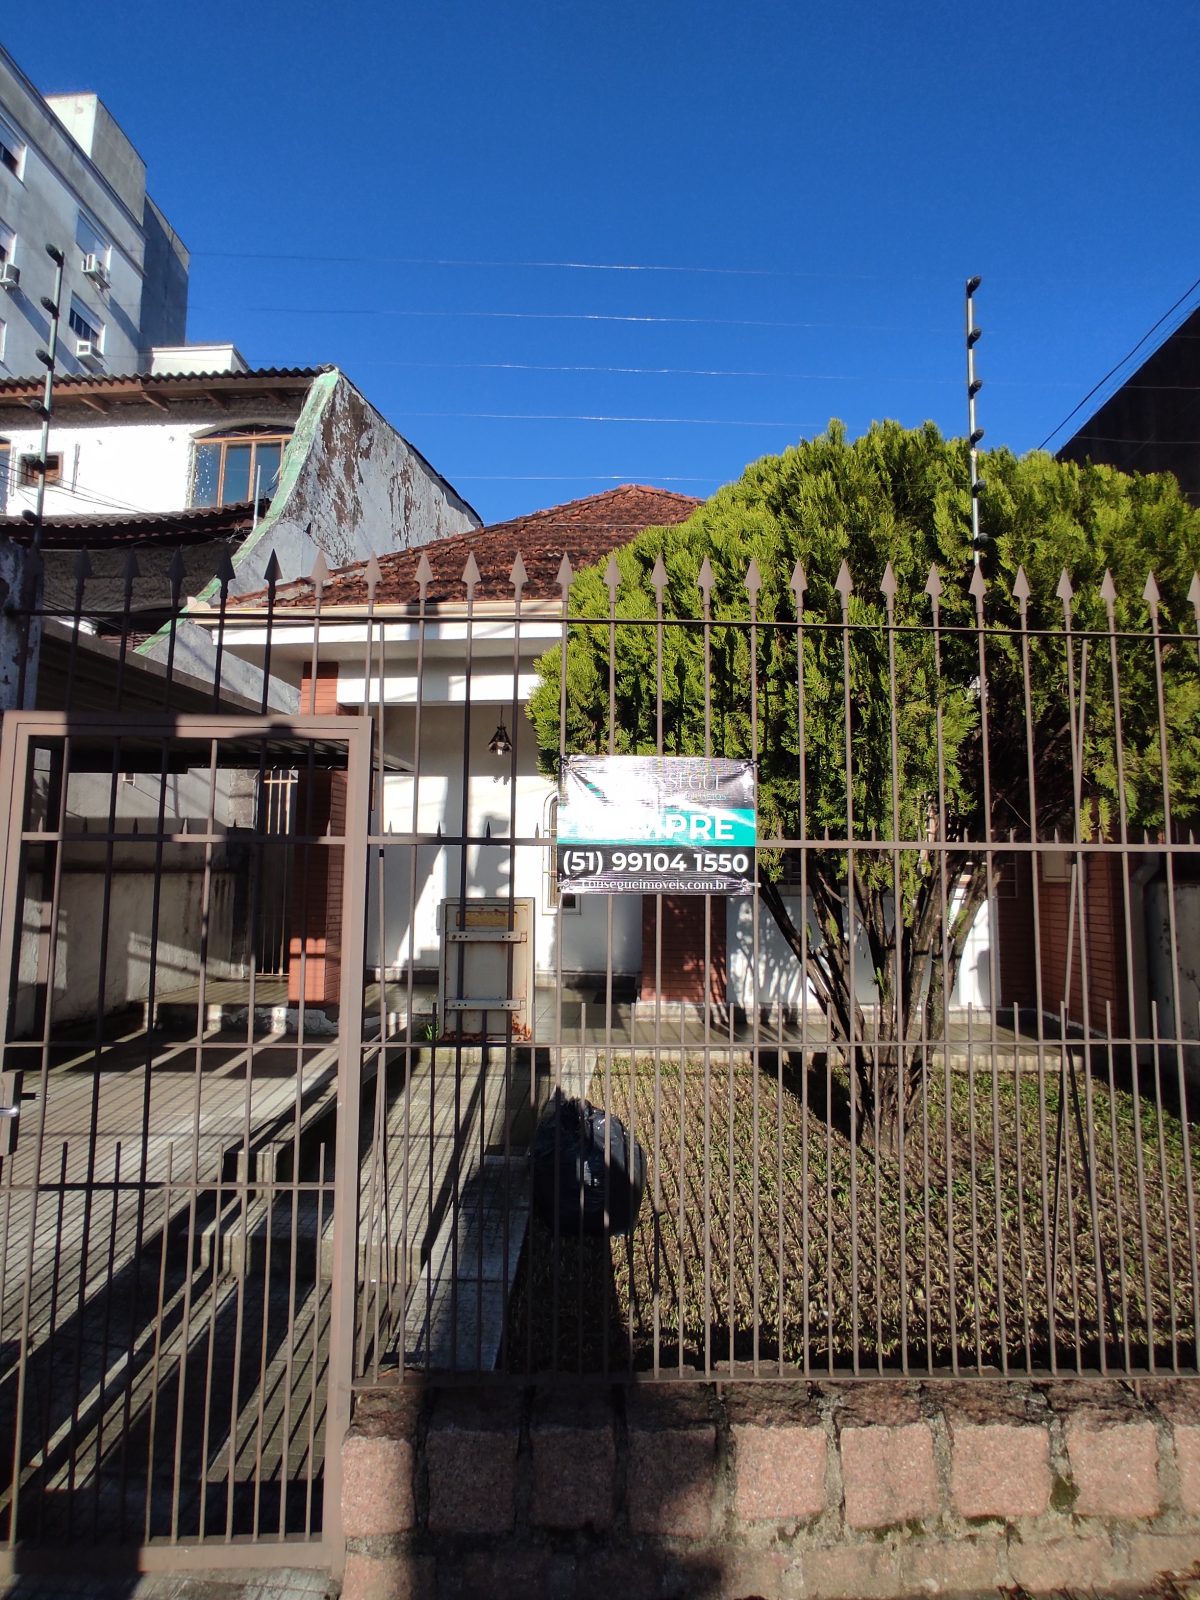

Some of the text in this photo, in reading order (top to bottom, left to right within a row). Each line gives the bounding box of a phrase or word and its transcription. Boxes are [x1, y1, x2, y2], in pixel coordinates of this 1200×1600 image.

[645, 773, 724, 791] NSEGUE
[563, 850, 749, 875] (51) 99104 1550
[581, 878, 728, 891] consegueimoveis.com.br
